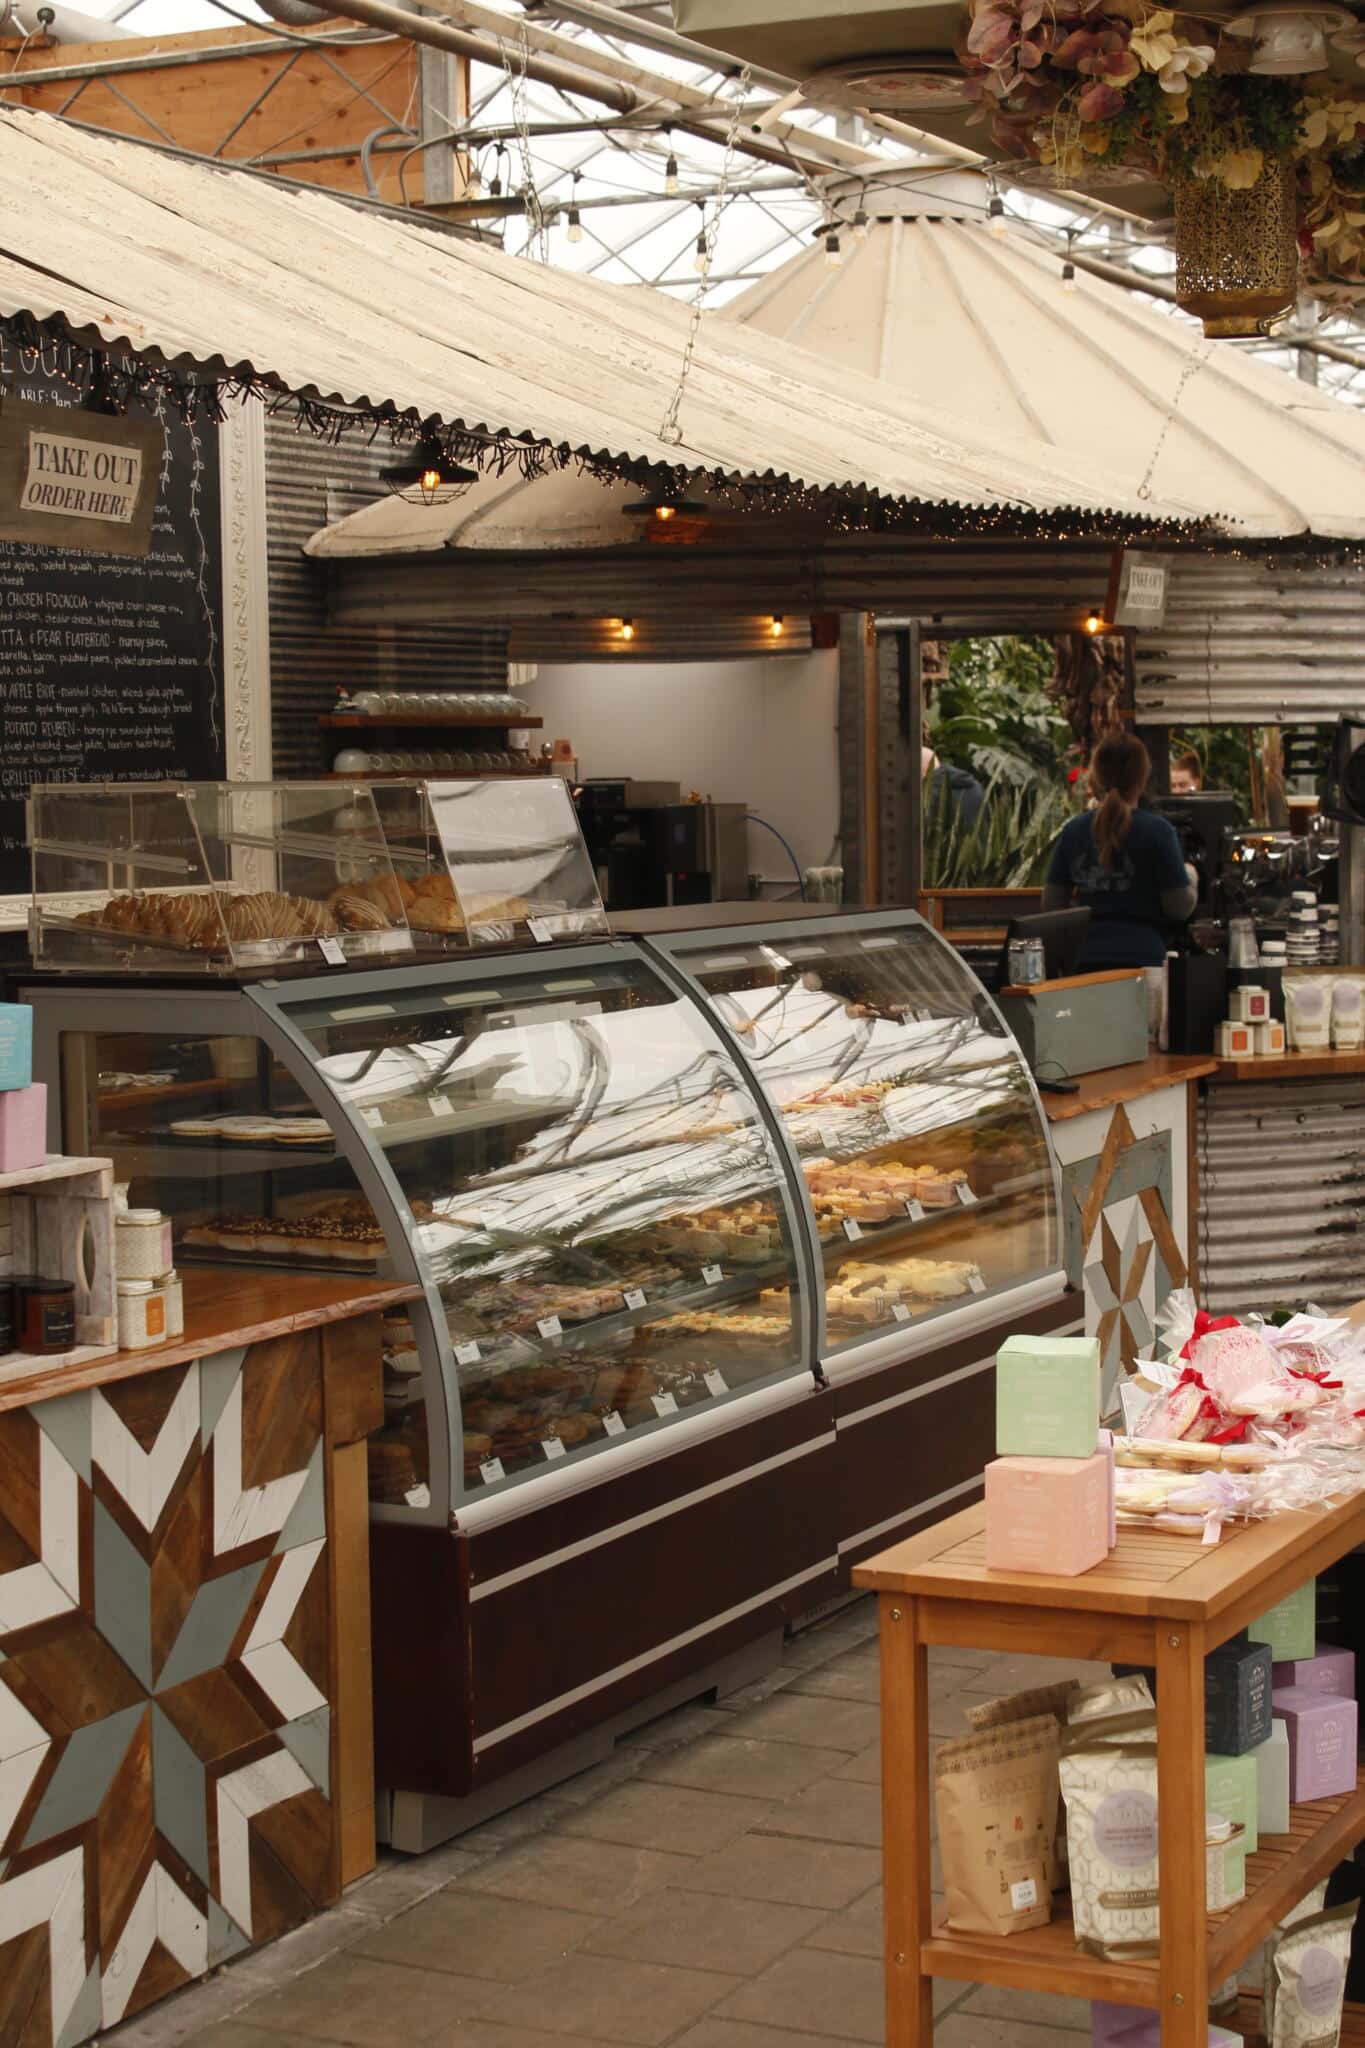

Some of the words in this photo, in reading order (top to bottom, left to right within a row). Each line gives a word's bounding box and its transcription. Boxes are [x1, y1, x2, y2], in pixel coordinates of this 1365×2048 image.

[34, 442, 89, 479] TAKE
[94, 452, 138, 486] OUT
[28, 482, 88, 511] ORDER
[88, 488, 129, 517] HERE
[7, 592, 43, 607] CHICKEN
[46, 592, 88, 609] FOCACCIA
[36, 629, 62, 647] PEAR
[65, 631, 110, 648] FLATBREAD
[9, 682, 33, 699] APPLE
[5, 721, 37, 736] POTATO
[41, 721, 75, 737] REUBEN
[2, 769, 41, 786] GRILLED
[46, 767, 80, 784] CHEESE
